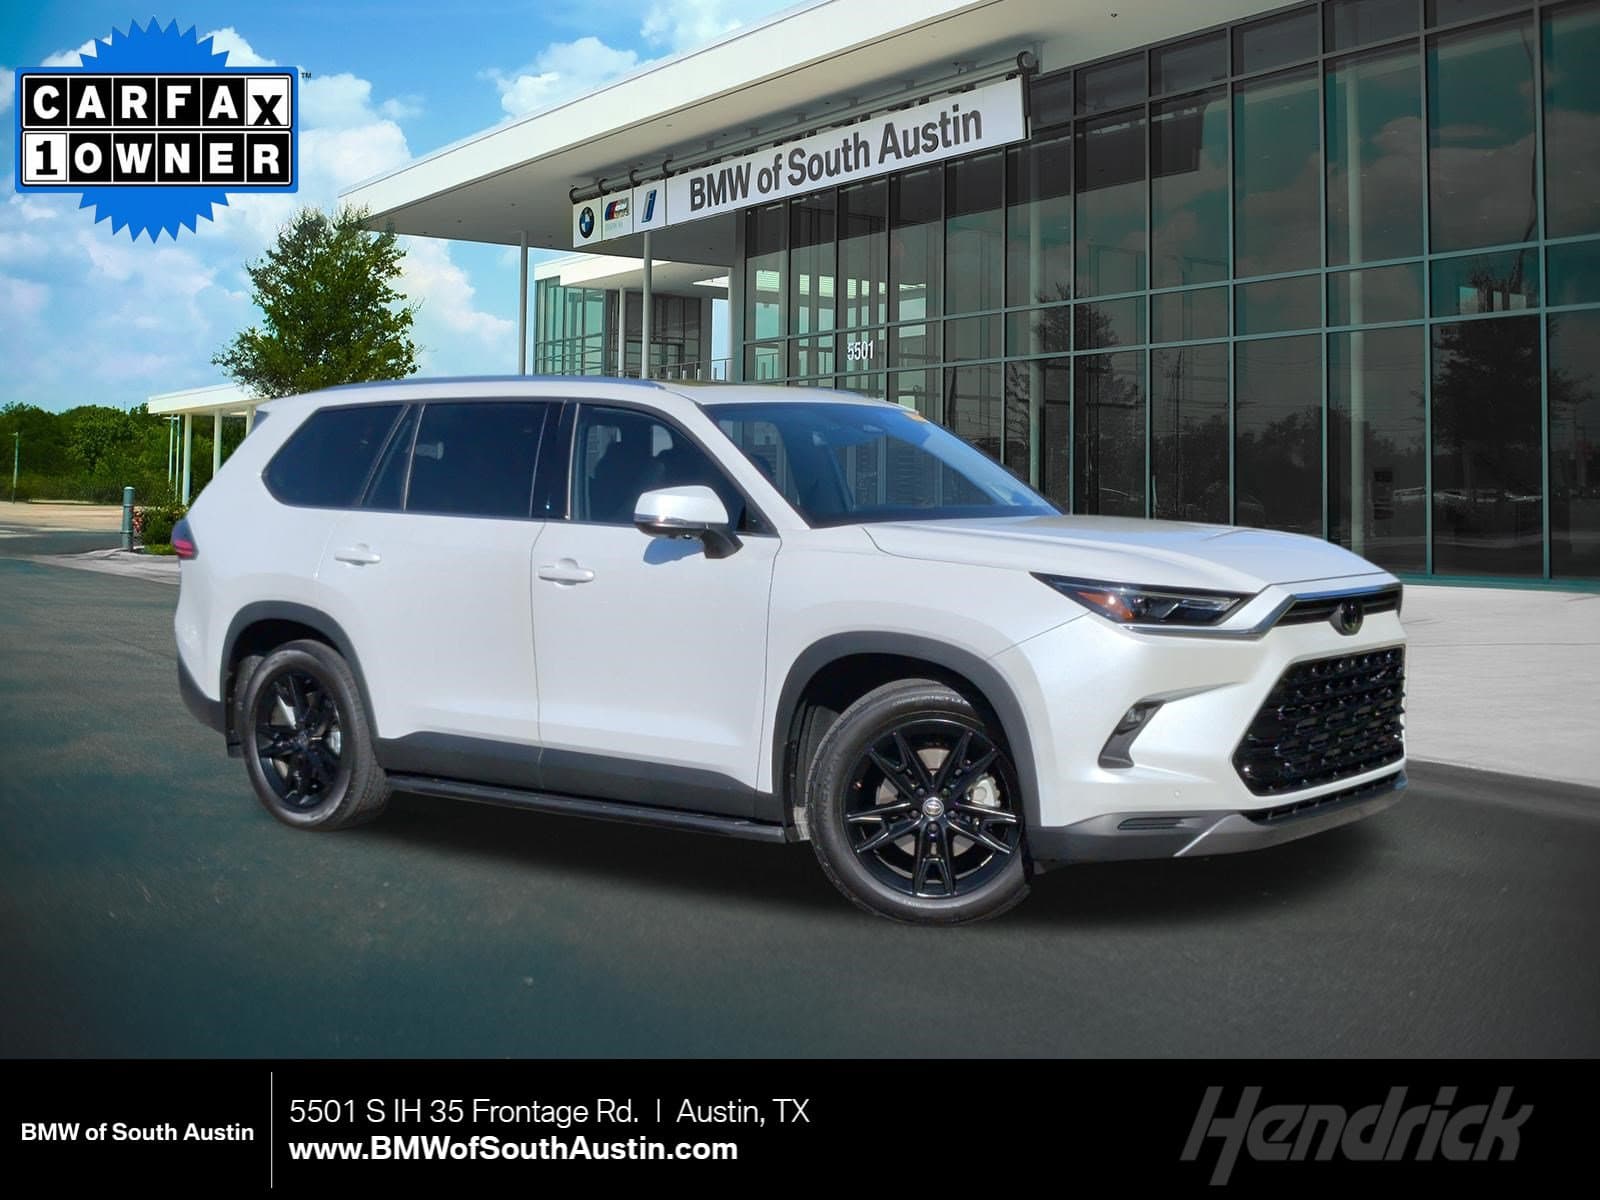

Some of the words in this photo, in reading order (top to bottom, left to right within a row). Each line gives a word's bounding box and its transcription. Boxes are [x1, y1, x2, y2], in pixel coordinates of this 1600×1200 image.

[690, 162, 751, 211] BMW
[757, 153, 782, 194] of
[787, 132, 870, 186] South
[878, 104, 982, 164] Austin
[847, 340, 873, 360] 5501
